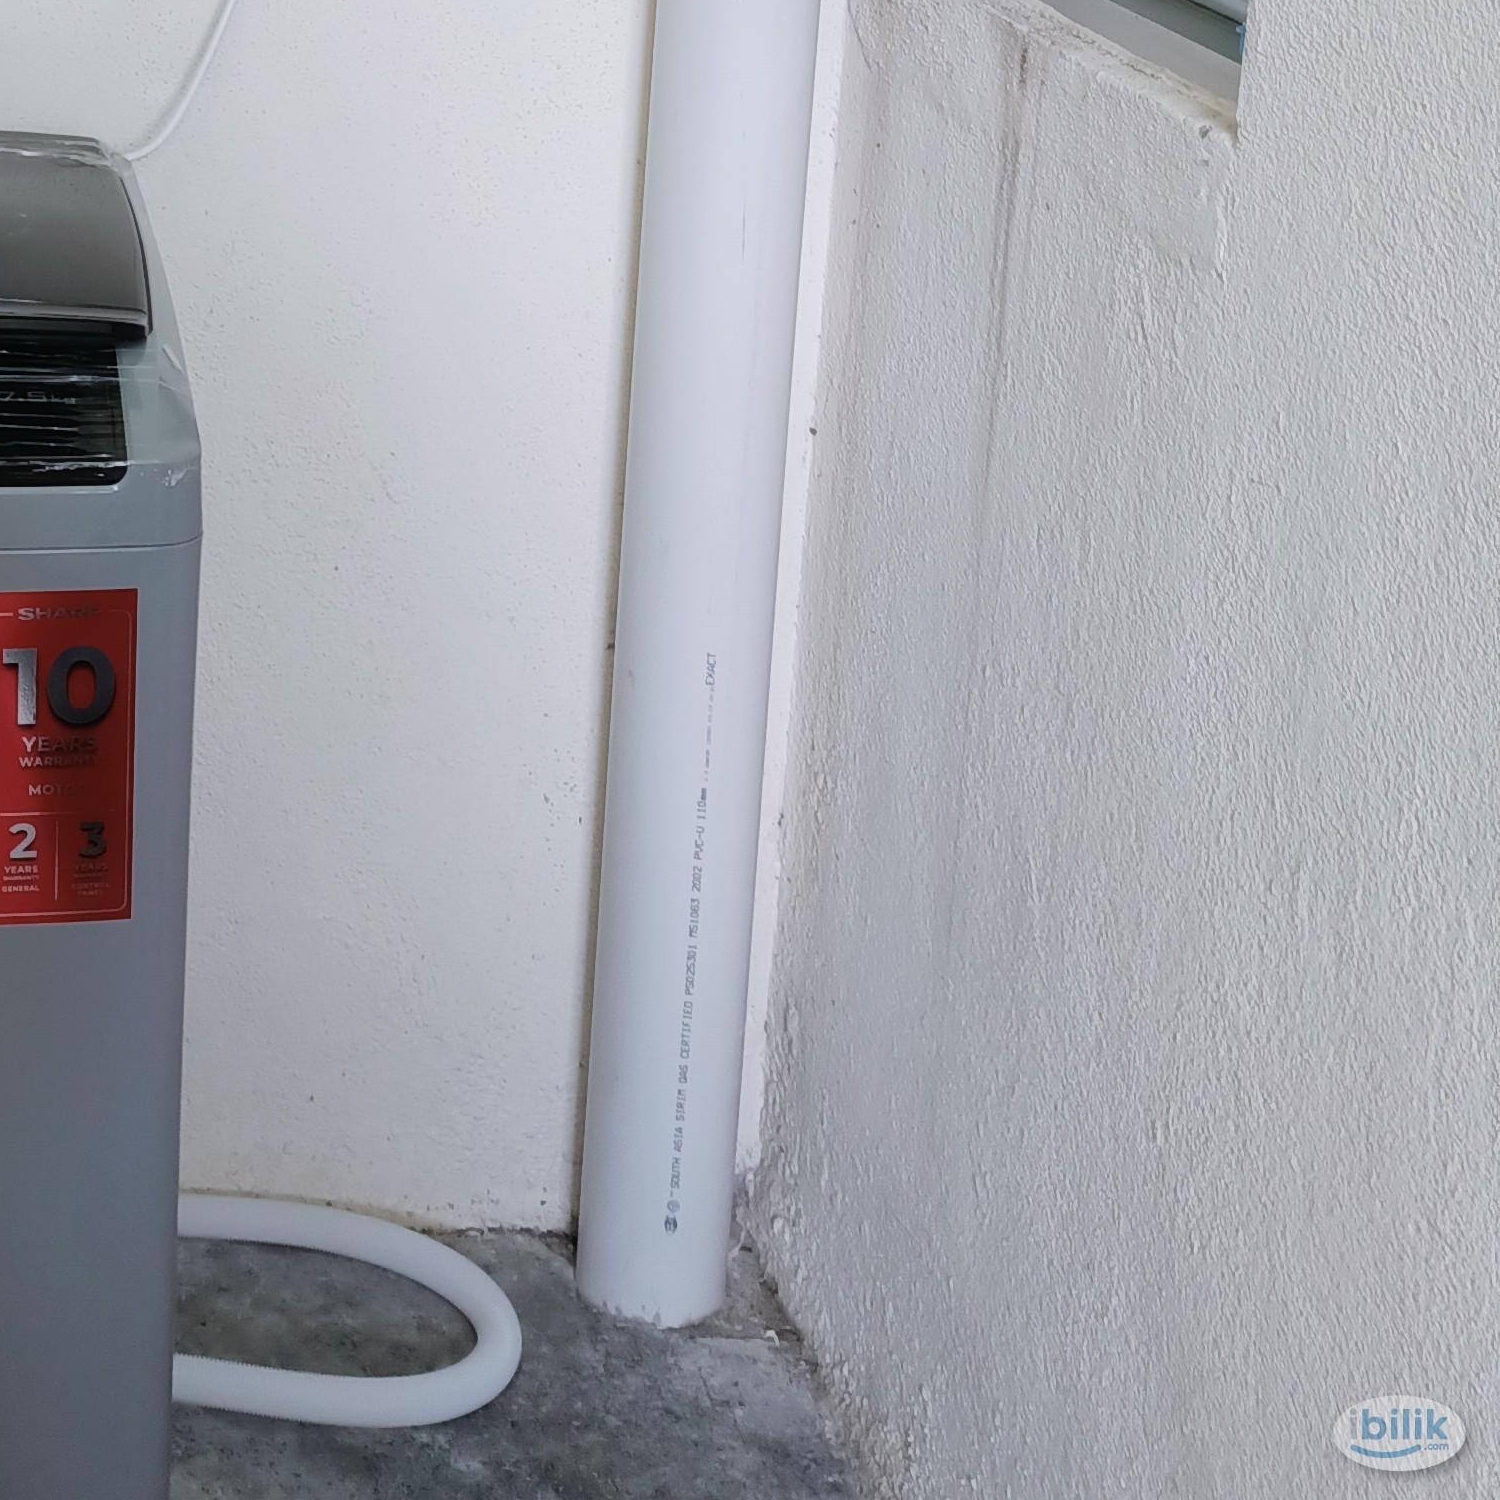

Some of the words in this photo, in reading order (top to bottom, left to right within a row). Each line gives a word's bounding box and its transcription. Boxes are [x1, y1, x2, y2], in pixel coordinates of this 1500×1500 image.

[2, 645, 116, 725] 10
[705, 652, 717, 686] EXACT
[21, 734, 97, 753] YEARS
[28, 784, 86, 796] MOTO
[8, 822, 38, 859] 2
[78, 821, 107, 860] 3
[694, 825, 705, 861] PVC-U
[3, 864, 39, 874] YEARS
[691, 865, 703, 893] 2002
[2, 884, 40, 893] GENERAL
[680, 1000, 693, 1059] CERTIFIED
